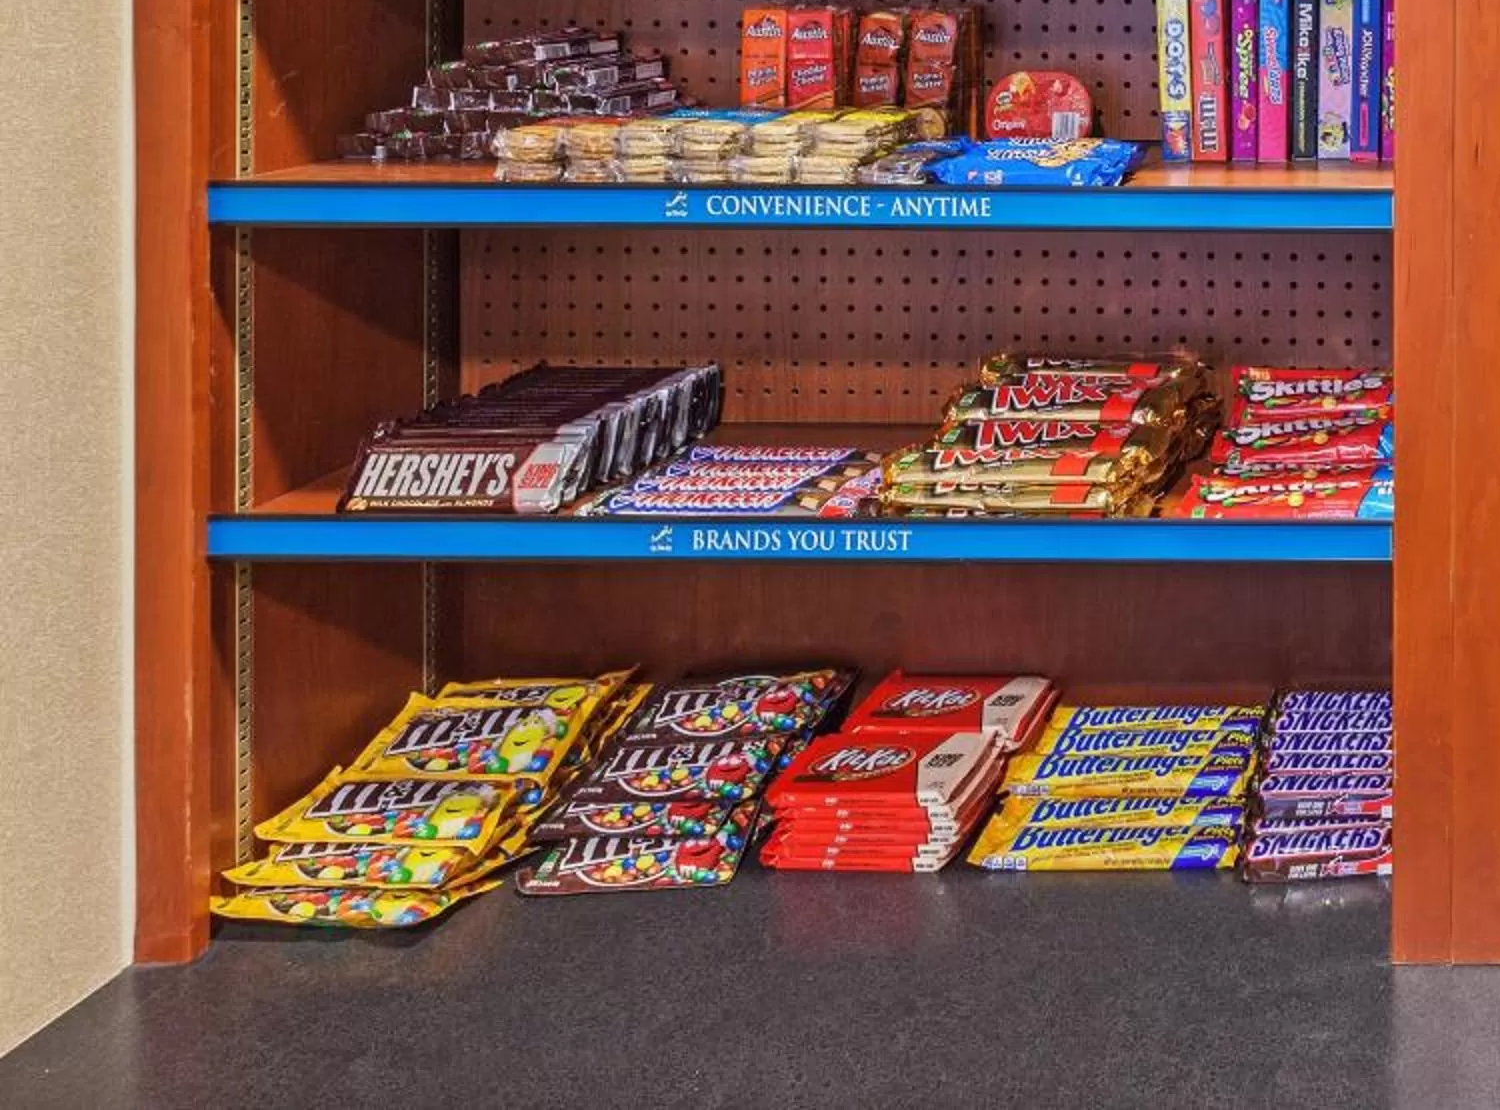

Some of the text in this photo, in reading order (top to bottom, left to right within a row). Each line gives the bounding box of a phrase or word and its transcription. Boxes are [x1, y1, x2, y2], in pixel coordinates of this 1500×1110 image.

[1298, 3, 1313, 47] Mike
[706, 194, 991, 219] CONVENIENCE ANYTIME
[1249, 376, 1383, 401] Skittles
[971, 419, 1097, 451] TWIX
[353, 452, 516, 497] HERSHEY'S
[691, 529, 913, 552] BRANDS YOU TRUST
